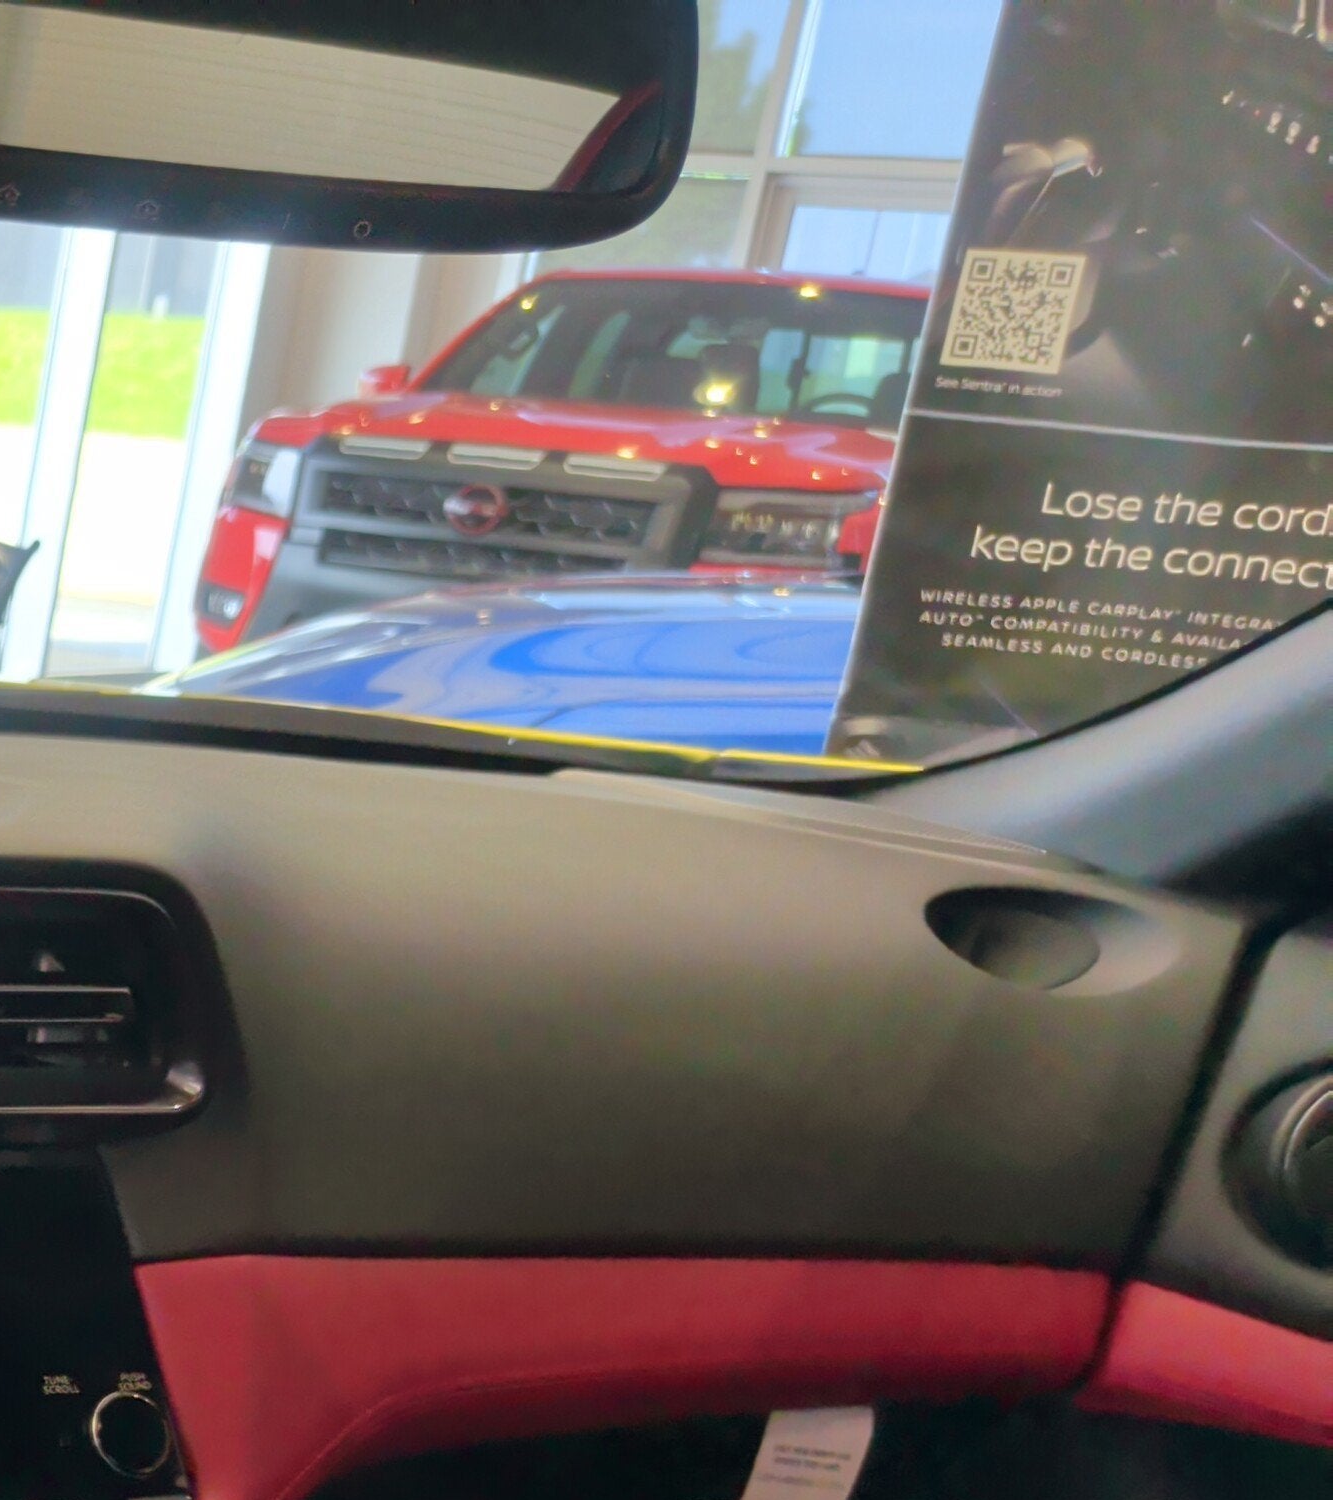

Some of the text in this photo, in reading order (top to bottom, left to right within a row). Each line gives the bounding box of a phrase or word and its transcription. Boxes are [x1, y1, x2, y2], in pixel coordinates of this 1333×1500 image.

[1041, 481, 1142, 522] Lose
[1154, 492, 1222, 526] the
[970, 524, 1072, 572] keep
[1084, 538, 1153, 571] the
[920, 589, 1013, 610] WIRELESS
[1019, 596, 1080, 615] APPLE
[941, 633, 1043, 655] SEAMLESS
[1050, 641, 1092, 658] AND
[990, 615, 1143, 642] COMPATIBILITY
[1151, 630, 1163, 643] &
[1172, 631, 1245, 651] AVAILA
